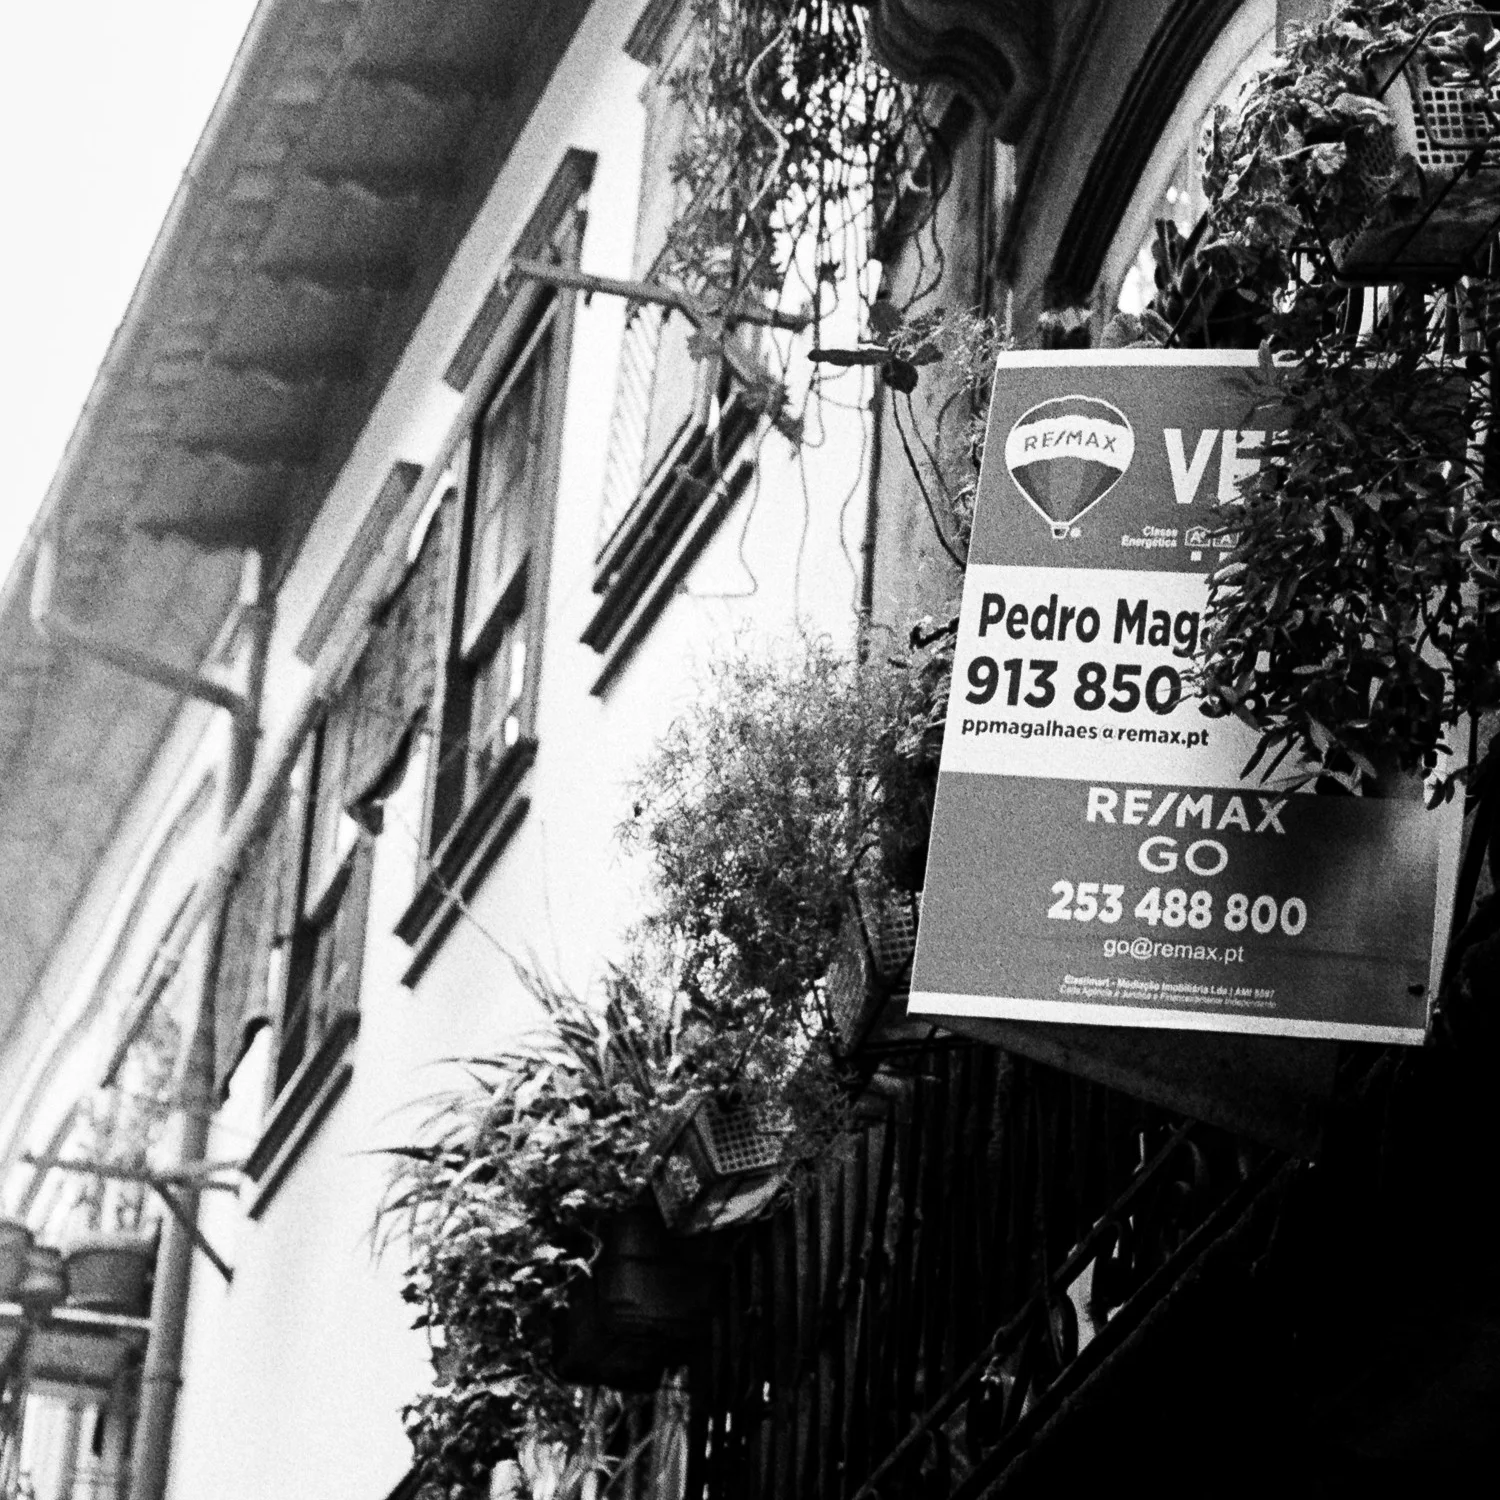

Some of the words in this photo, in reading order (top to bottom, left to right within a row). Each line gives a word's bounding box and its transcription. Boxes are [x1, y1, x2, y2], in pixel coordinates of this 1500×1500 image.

[1024, 430, 1117, 453] RE/MAX
[978, 592, 1100, 643] Pedro
[965, 655, 1058, 708] 913
[1073, 661, 1183, 715] 850
[1086, 786, 1288, 834] RE/MAX
[1138, 835, 1229, 876] GO
[1047, 879, 1125, 923] 253
[1134, 886, 1213, 930] 488
[1223, 893, 1308, 936] 800
[1103, 936, 1245, 965] go@remax.pt
